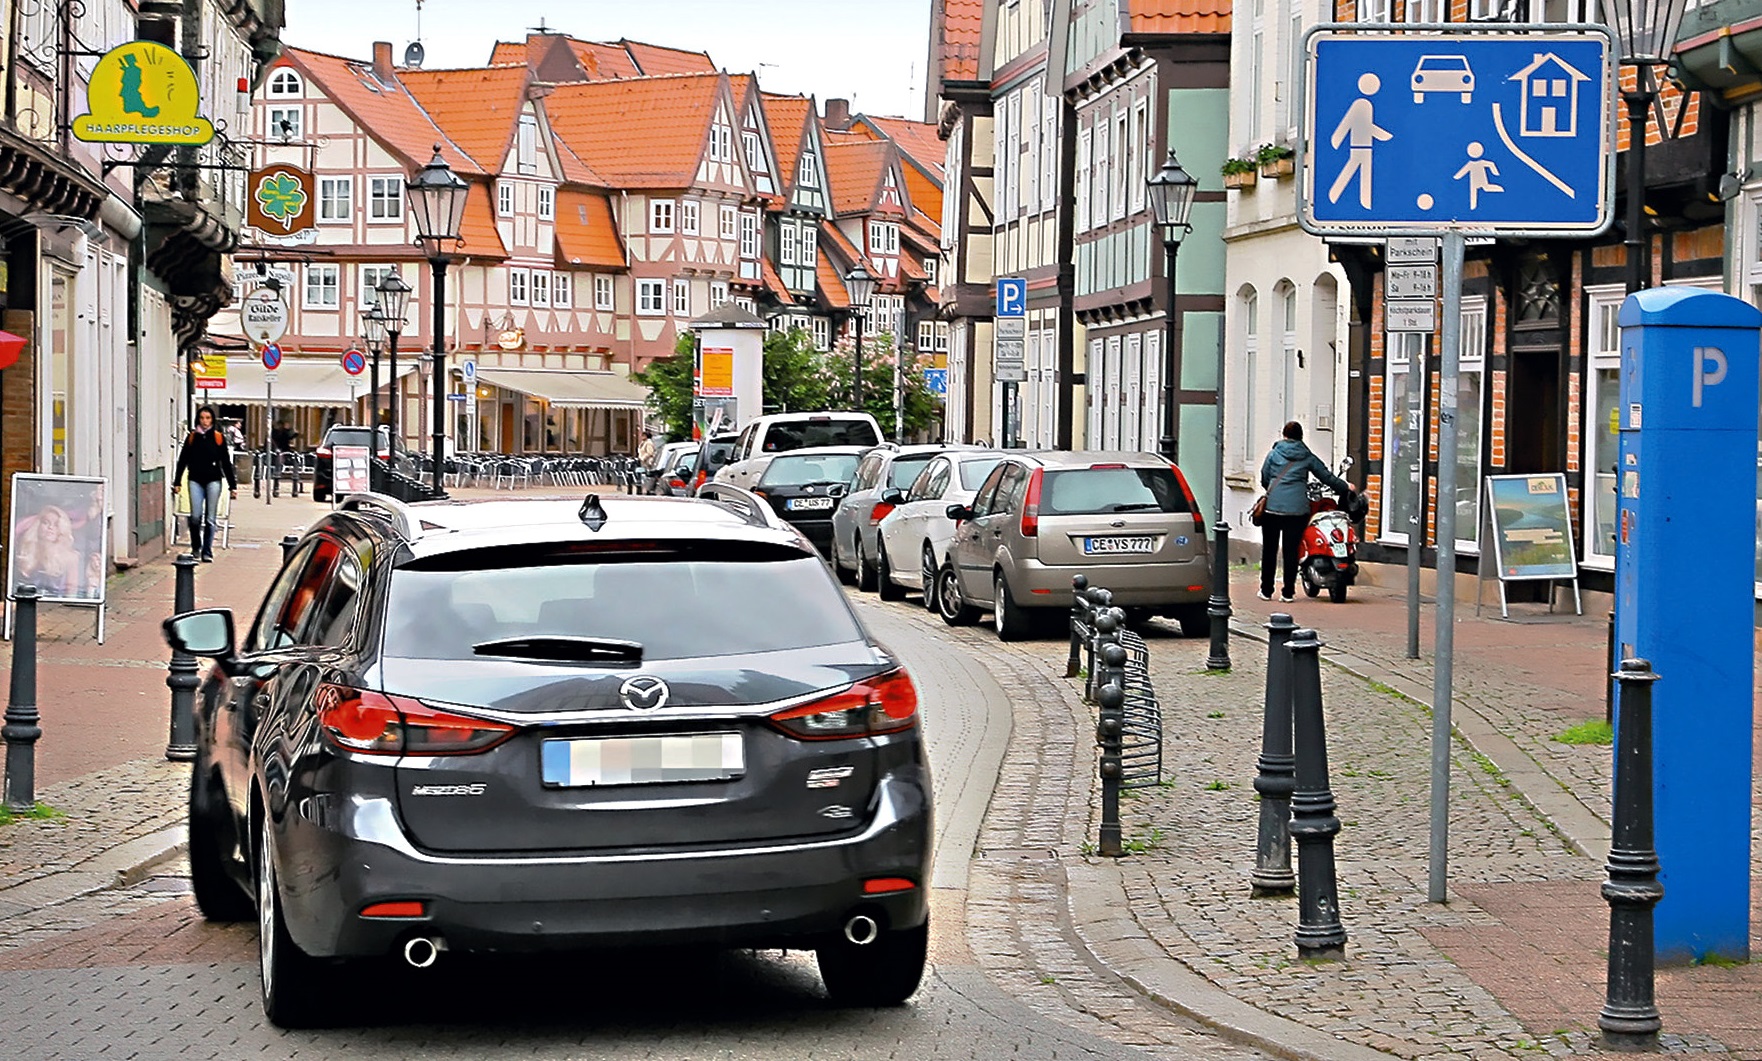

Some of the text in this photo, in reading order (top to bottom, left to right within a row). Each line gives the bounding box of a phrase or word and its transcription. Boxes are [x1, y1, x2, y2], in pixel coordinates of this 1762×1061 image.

[86, 124, 200, 136] HAARPFLEGESHOP
[1390, 246, 1433, 257] Parkschein
[1003, 283, 1020, 312] P
[250, 304, 279, 313] Gilde
[1692, 346, 1728, 408] P
[793, 499, 804, 508] CE
[1092, 538, 1107, 551] CE
